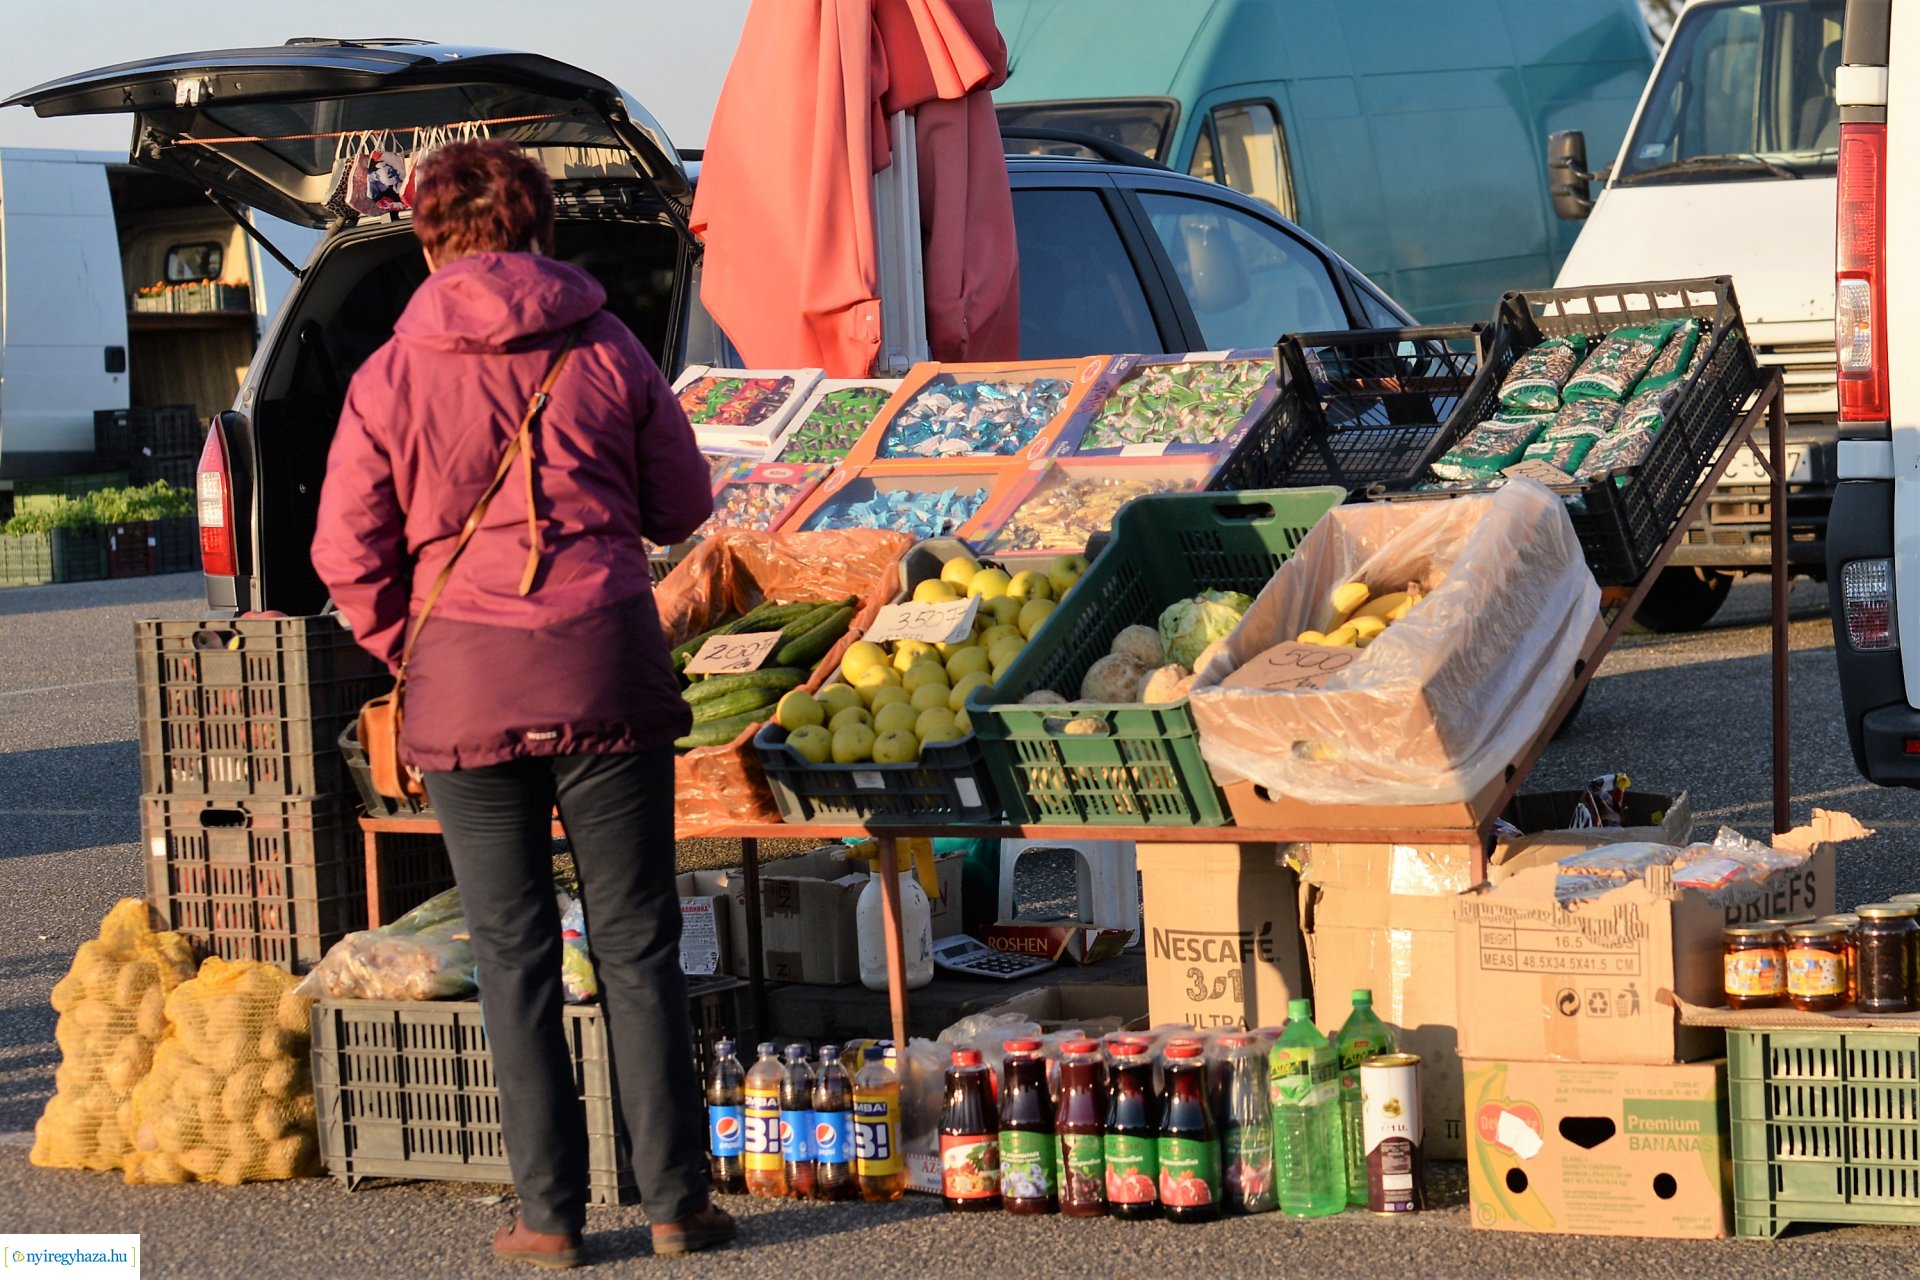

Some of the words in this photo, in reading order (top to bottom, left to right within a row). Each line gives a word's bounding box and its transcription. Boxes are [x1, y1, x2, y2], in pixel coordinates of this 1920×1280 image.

[888, 611, 945, 631] 350
[704, 642, 760, 661] 200
[1269, 649, 1353, 671] 500
[988, 937, 1049, 952] ROSHEN
[1153, 922, 1274, 963] NESCAFÉ
[1483, 933, 1513, 946] WEIGHT
[1554, 936, 1583, 949] 16.5
[1483, 953, 1514, 967] MEAS
[1522, 955, 1607, 970] 48.5X34.5X41.5
[1616, 958, 1634, 971] CM
[1628, 1114, 1700, 1132] Premium
[1629, 1136, 1713, 1152] BANANAS
